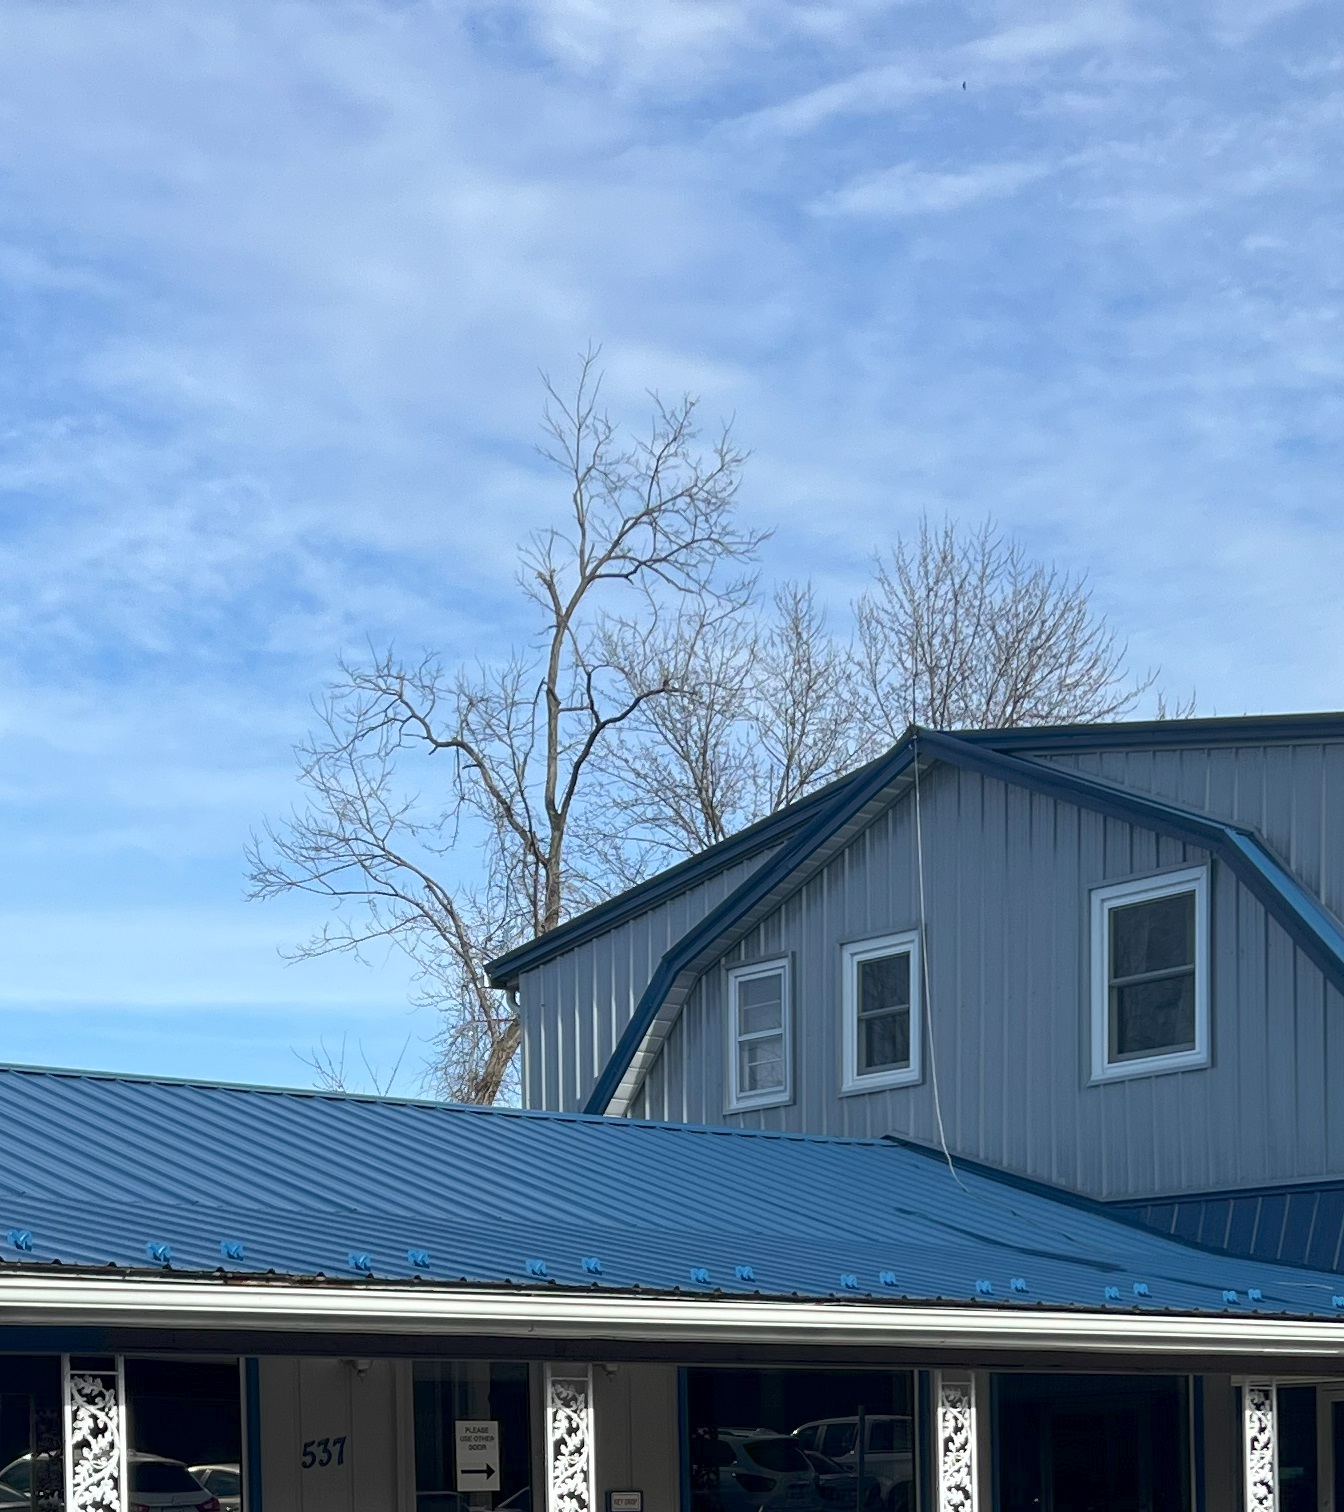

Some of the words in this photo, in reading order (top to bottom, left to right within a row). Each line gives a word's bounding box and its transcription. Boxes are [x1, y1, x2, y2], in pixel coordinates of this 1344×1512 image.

[464, 1426, 489, 1434] PLEASE
[468, 1443, 488, 1451] DOOR
[302, 1436, 346, 1469] 537
